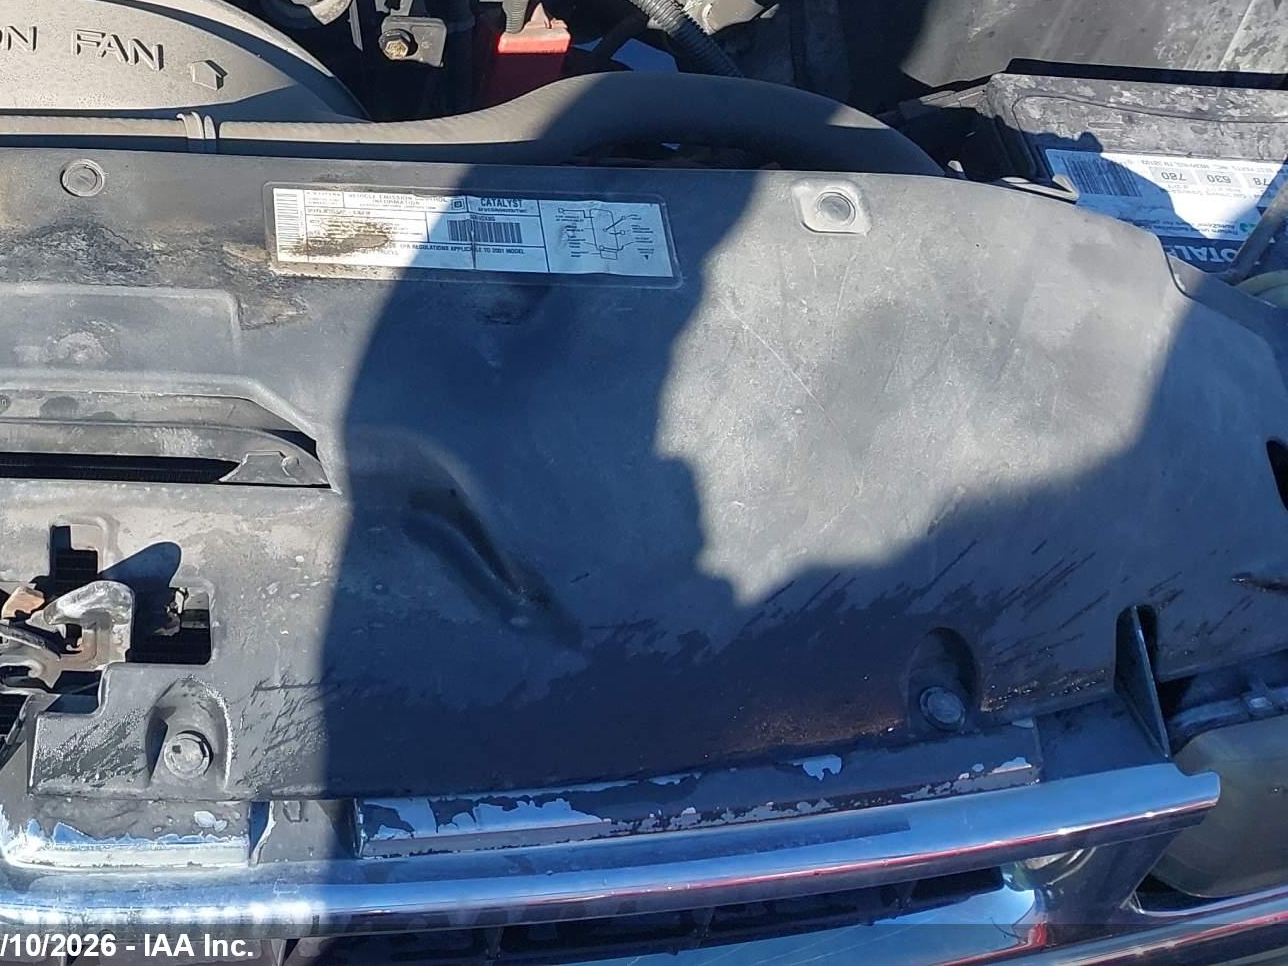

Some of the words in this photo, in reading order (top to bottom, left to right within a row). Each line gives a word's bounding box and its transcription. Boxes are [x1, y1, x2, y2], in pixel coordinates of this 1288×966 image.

[72, 28, 165, 72] FAN
[1161, 171, 1186, 181] 780
[1206, 174, 1232, 183] 630
[480, 197, 523, 208] CATALYST
